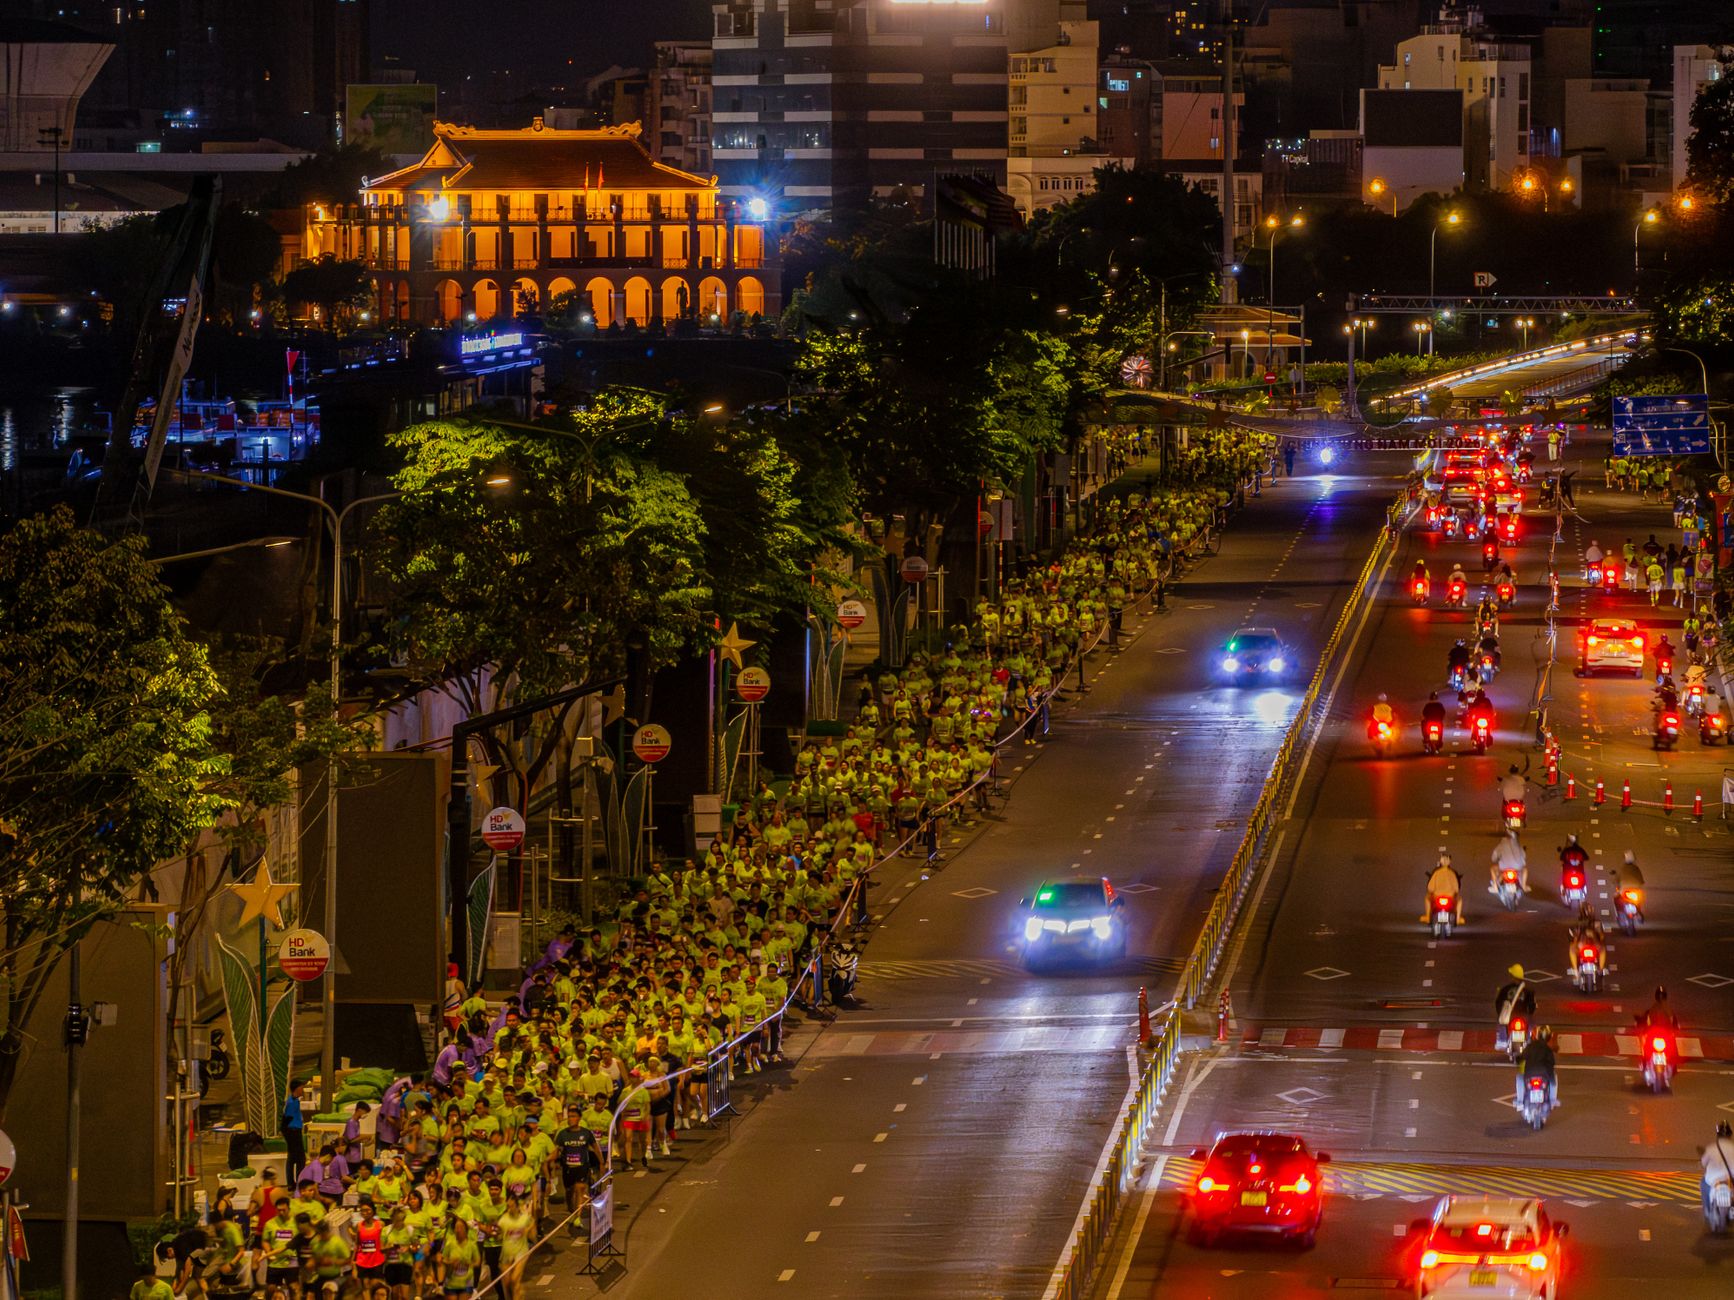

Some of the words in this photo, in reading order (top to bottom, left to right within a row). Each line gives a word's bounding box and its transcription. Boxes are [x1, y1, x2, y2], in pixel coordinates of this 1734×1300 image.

[490, 815, 503, 823] HD
[491, 823, 512, 831] Bank
[289, 937, 304, 947] HD
[289, 947, 316, 957] Bank
